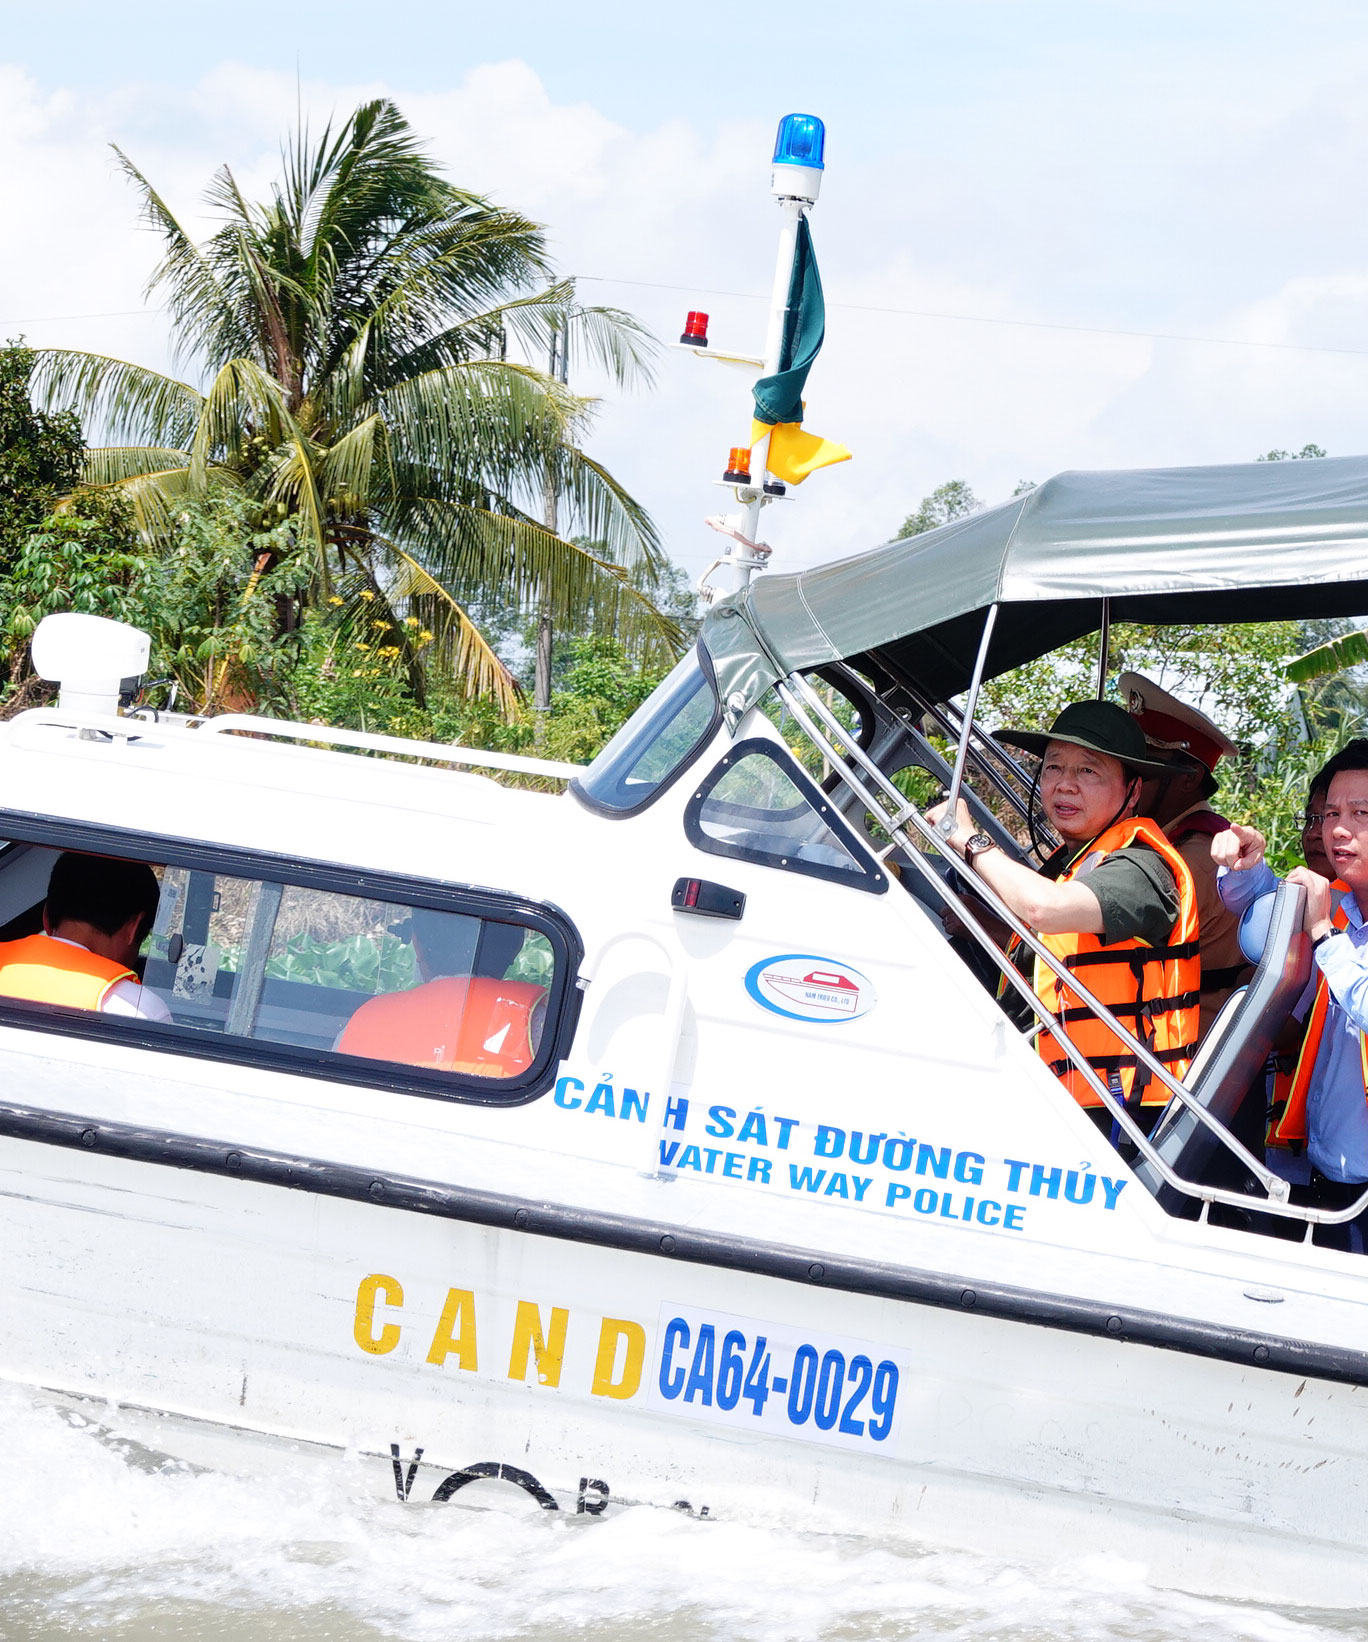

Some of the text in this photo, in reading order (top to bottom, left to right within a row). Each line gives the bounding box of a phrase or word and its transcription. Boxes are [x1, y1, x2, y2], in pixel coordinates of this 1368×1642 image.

[553, 1072, 1129, 1211] CẢNH SÁT ĐƯỜNG THỦY
[789, 1164, 873, 1202] WAY
[885, 1182, 1028, 1232] POLICE
[658, 1316, 900, 1442] CA64-0029
